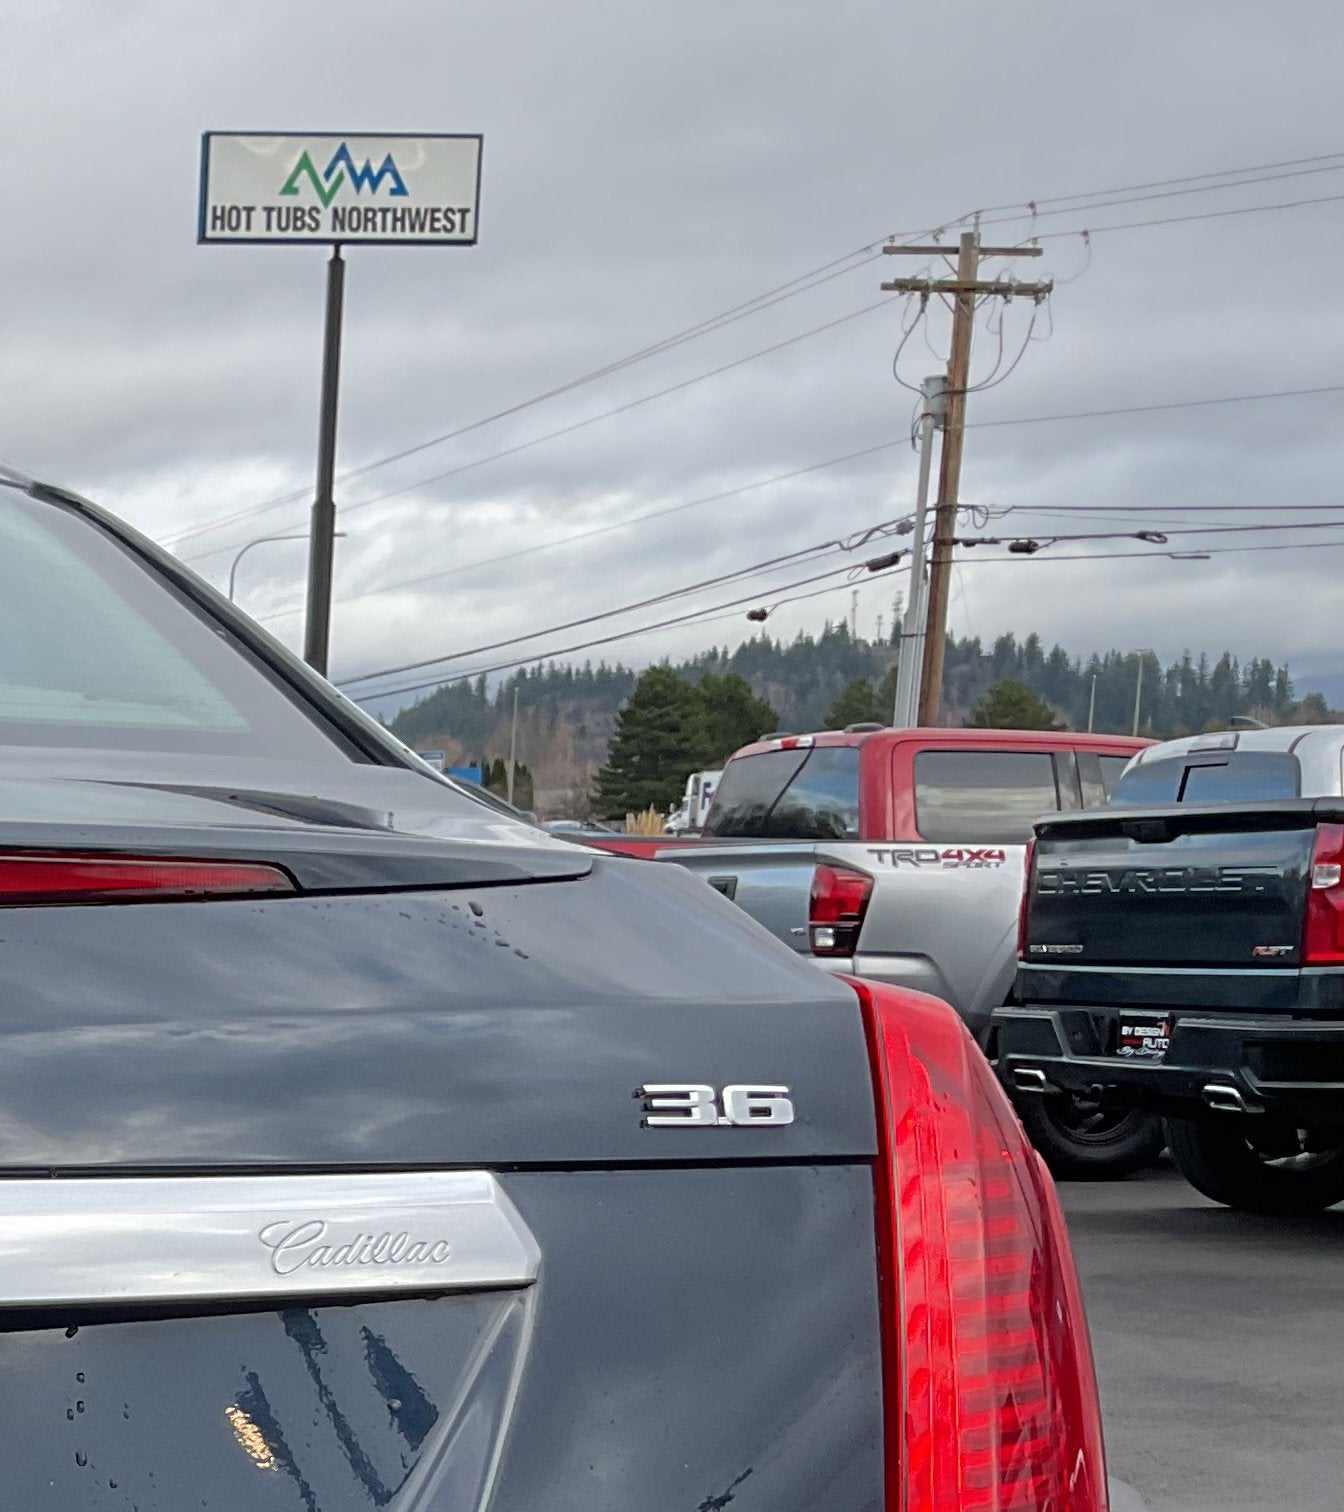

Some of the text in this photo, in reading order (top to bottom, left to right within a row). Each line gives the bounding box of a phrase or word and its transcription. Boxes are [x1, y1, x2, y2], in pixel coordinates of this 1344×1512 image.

[211, 206, 470, 234] HOT TUBS NORTHWEST
[1037, 866, 1283, 894] CHEVROLET
[259, 1220, 450, 1276] Cadillac
